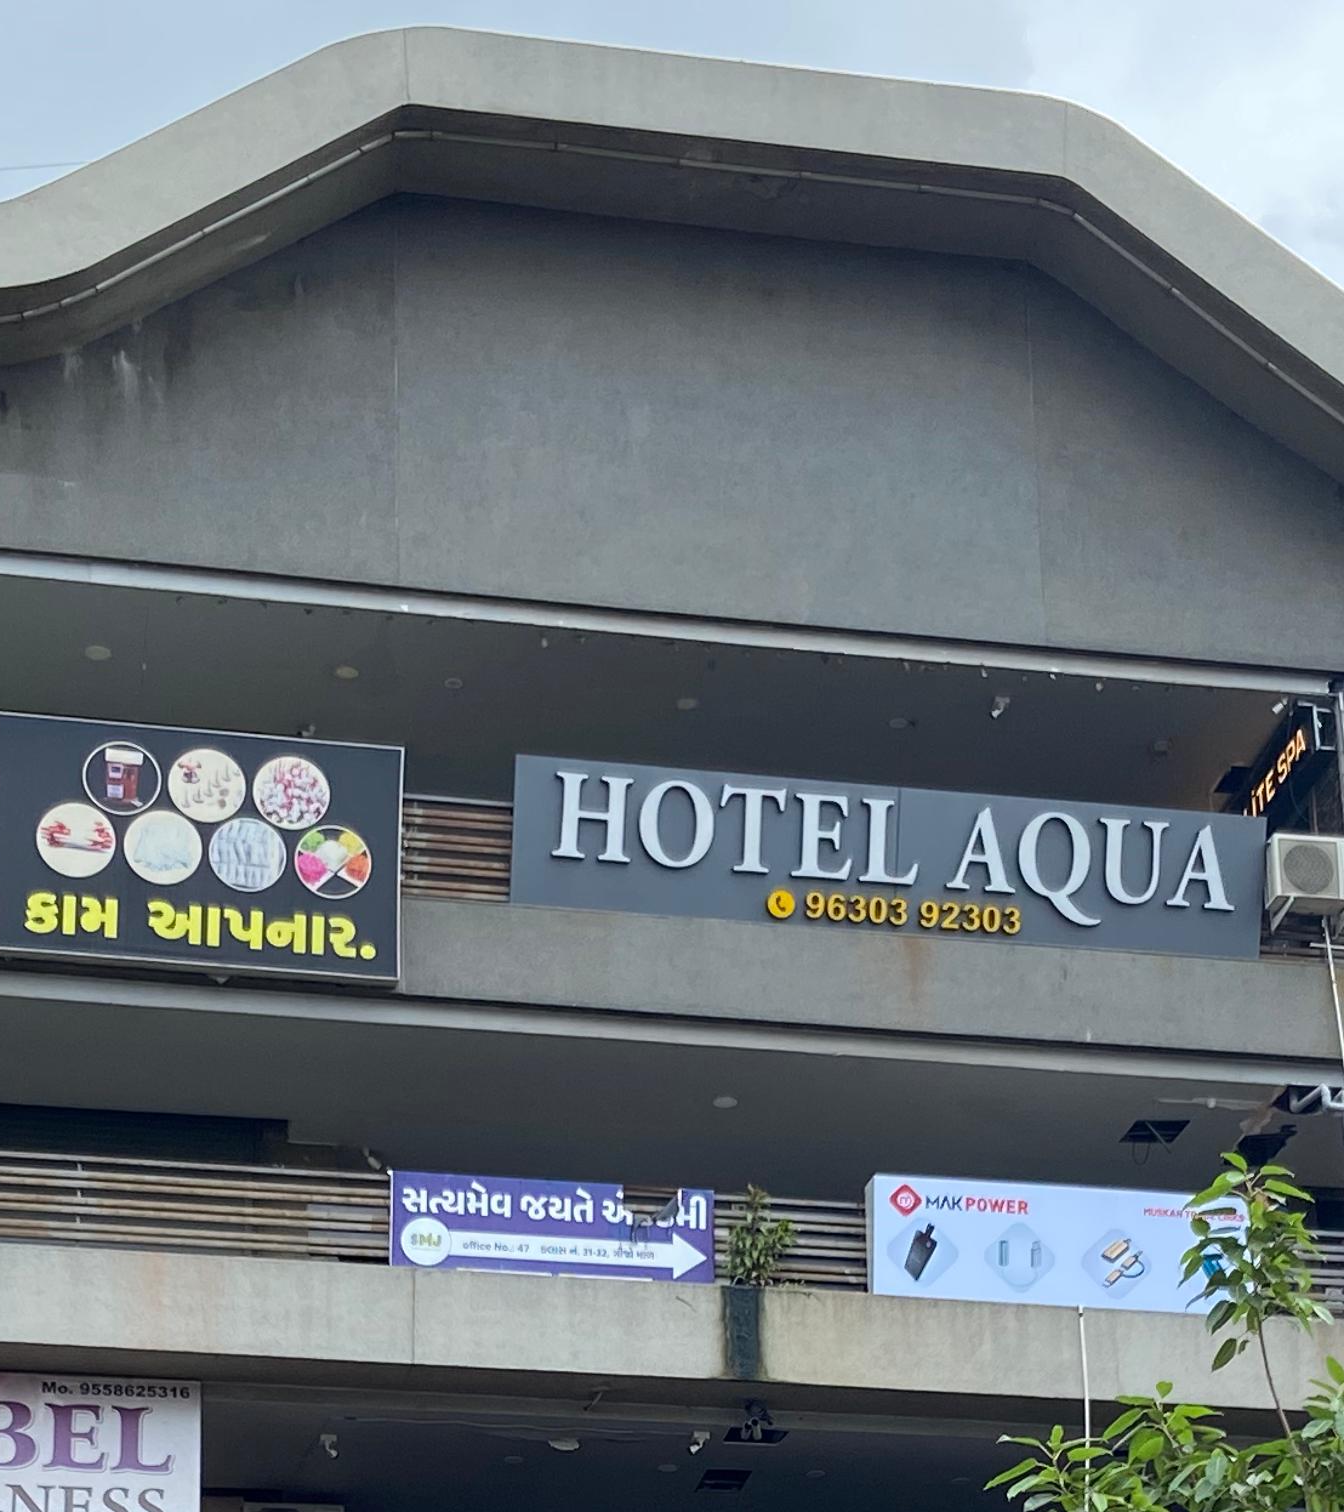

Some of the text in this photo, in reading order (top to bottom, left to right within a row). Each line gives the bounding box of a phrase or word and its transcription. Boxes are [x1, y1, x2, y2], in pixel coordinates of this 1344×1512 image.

[1277, 728, 1306, 784] SPA
[551, 769, 1238, 926] HOTEL AQUA
[24, 891, 121, 941] કામ
[805, 891, 1024, 935] 96303 92303
[401, 1180, 595, 1224] સત્યમેવ જયતે
[462, 1241, 492, 1252] office
[42, 1380, 191, 1400] Mo. 9558625316
